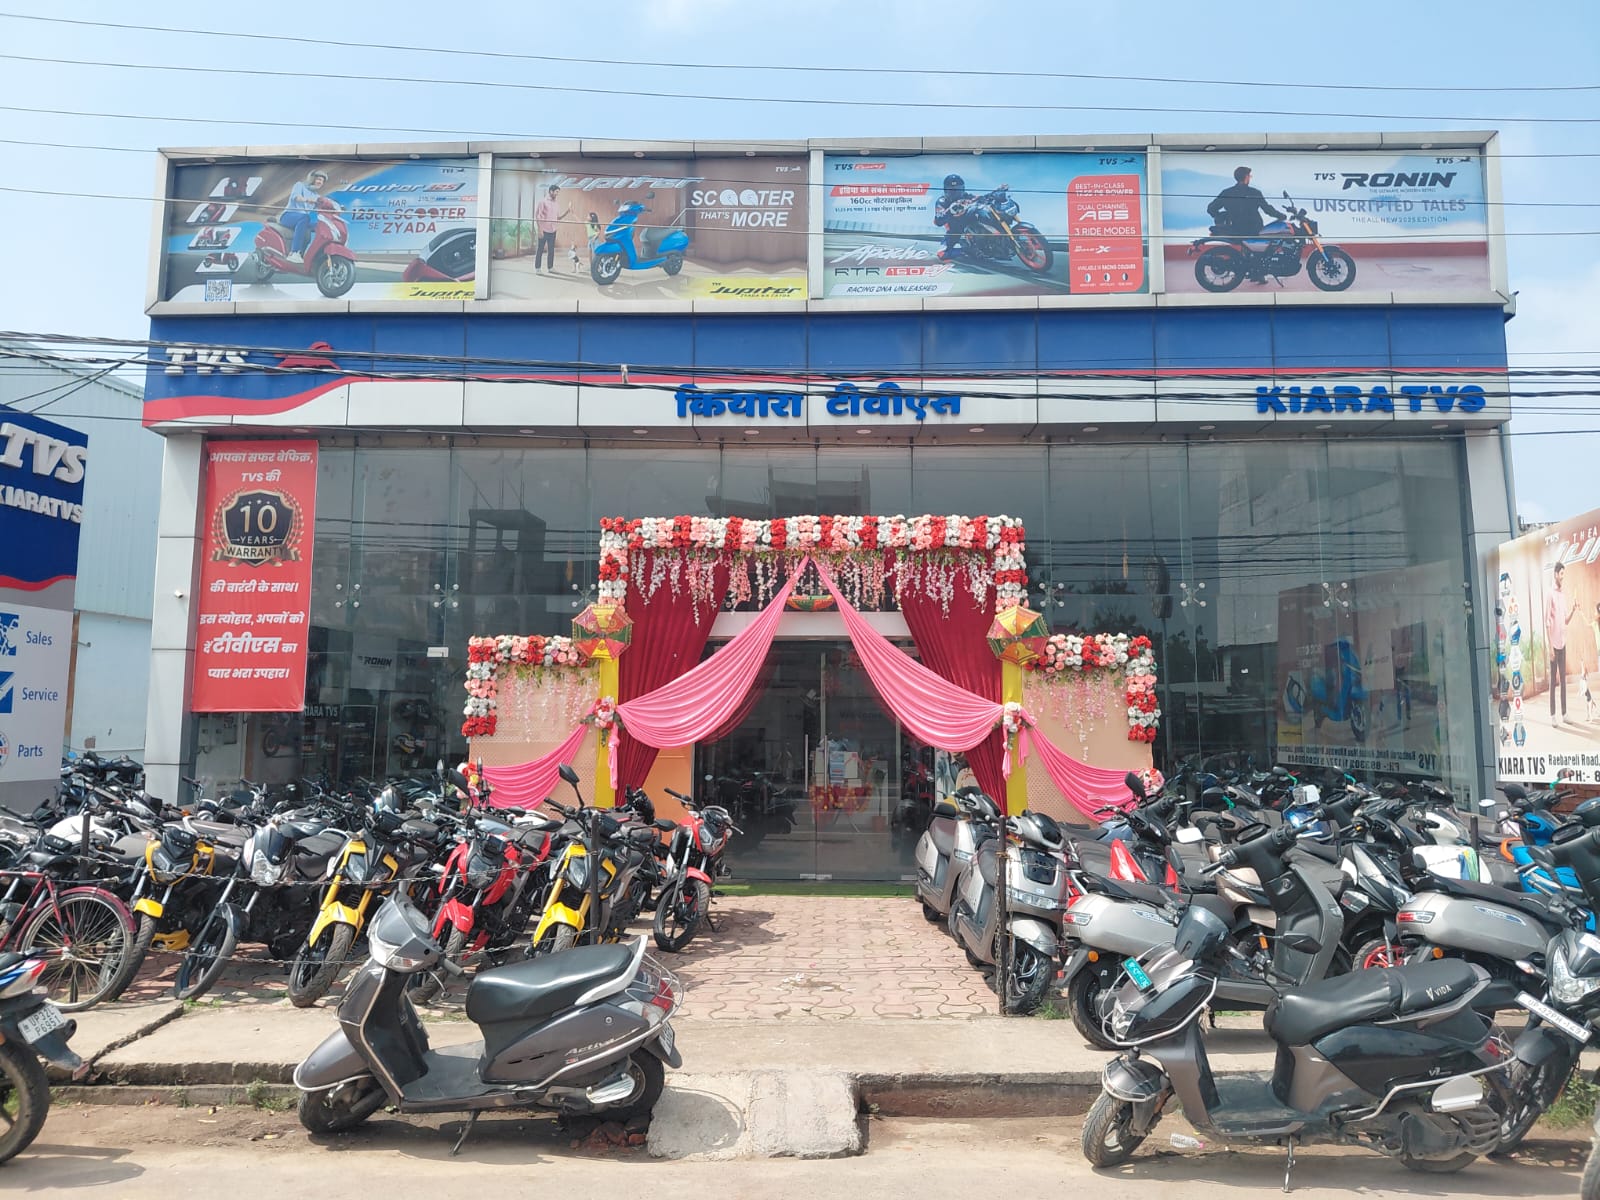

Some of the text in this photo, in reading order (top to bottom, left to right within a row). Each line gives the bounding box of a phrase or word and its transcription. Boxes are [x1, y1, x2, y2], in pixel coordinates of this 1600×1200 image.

[538, 175, 705, 192] Jupiter
[1314, 172, 1457, 190] TVS RONIN
[388, 199, 407, 208] HAR
[691, 189, 795, 207] SCOOTER
[850, 197, 872, 205] 160cc
[1313, 199, 1466, 213] UNSCRIPTED TALES
[700, 211, 789, 228] THAT'S MORE
[1079, 210, 1129, 221] ABS
[368, 222, 437, 234] SE ZYADA
[1082, 227, 1102, 236] RIDE
[1103, 226, 1137, 235] MODES
[829, 242, 935, 266] Apache
[835, 267, 880, 277] RTR
[709, 286, 802, 295] Jupiter
[875, 285, 892, 293] DNA
[893, 284, 938, 292] UNLEASHED
[163, 346, 250, 375] TVS
[674, 383, 805, 418] कियारा
[1255, 384, 1487, 414] KIARA TVS
[0, 422, 88, 485] TVS
[210, 452, 247, 464] आपका
[247, 452, 275, 463] सफर
[241, 469, 282, 482] TVS की
[239, 504, 278, 534] 10
[240, 535, 275, 545] YEARS
[225, 546, 284, 558] WARRANTY
[209, 579, 225, 593] की
[226, 578, 257, 593] वारंटी
[257, 579, 269, 593] के
[255, 610, 288, 624] अपनों
[288, 610, 305, 625] को
[26, 629, 53, 646] Sales
[211, 631, 282, 654] टीवीएस
[281, 642, 299, 654] का
[207, 667, 231, 679] प्यार
[231, 667, 253, 679] भरा
[22, 687, 59, 702] Service
[325, 705, 338, 718] TVS
[17, 744, 44, 758] Parts
[1498, 756, 1525, 776] KIARA
[1527, 756, 1546, 775] TVS
[1548, 753, 1580, 767] Raebareli
[1434, 984, 1452, 997] VIDA
